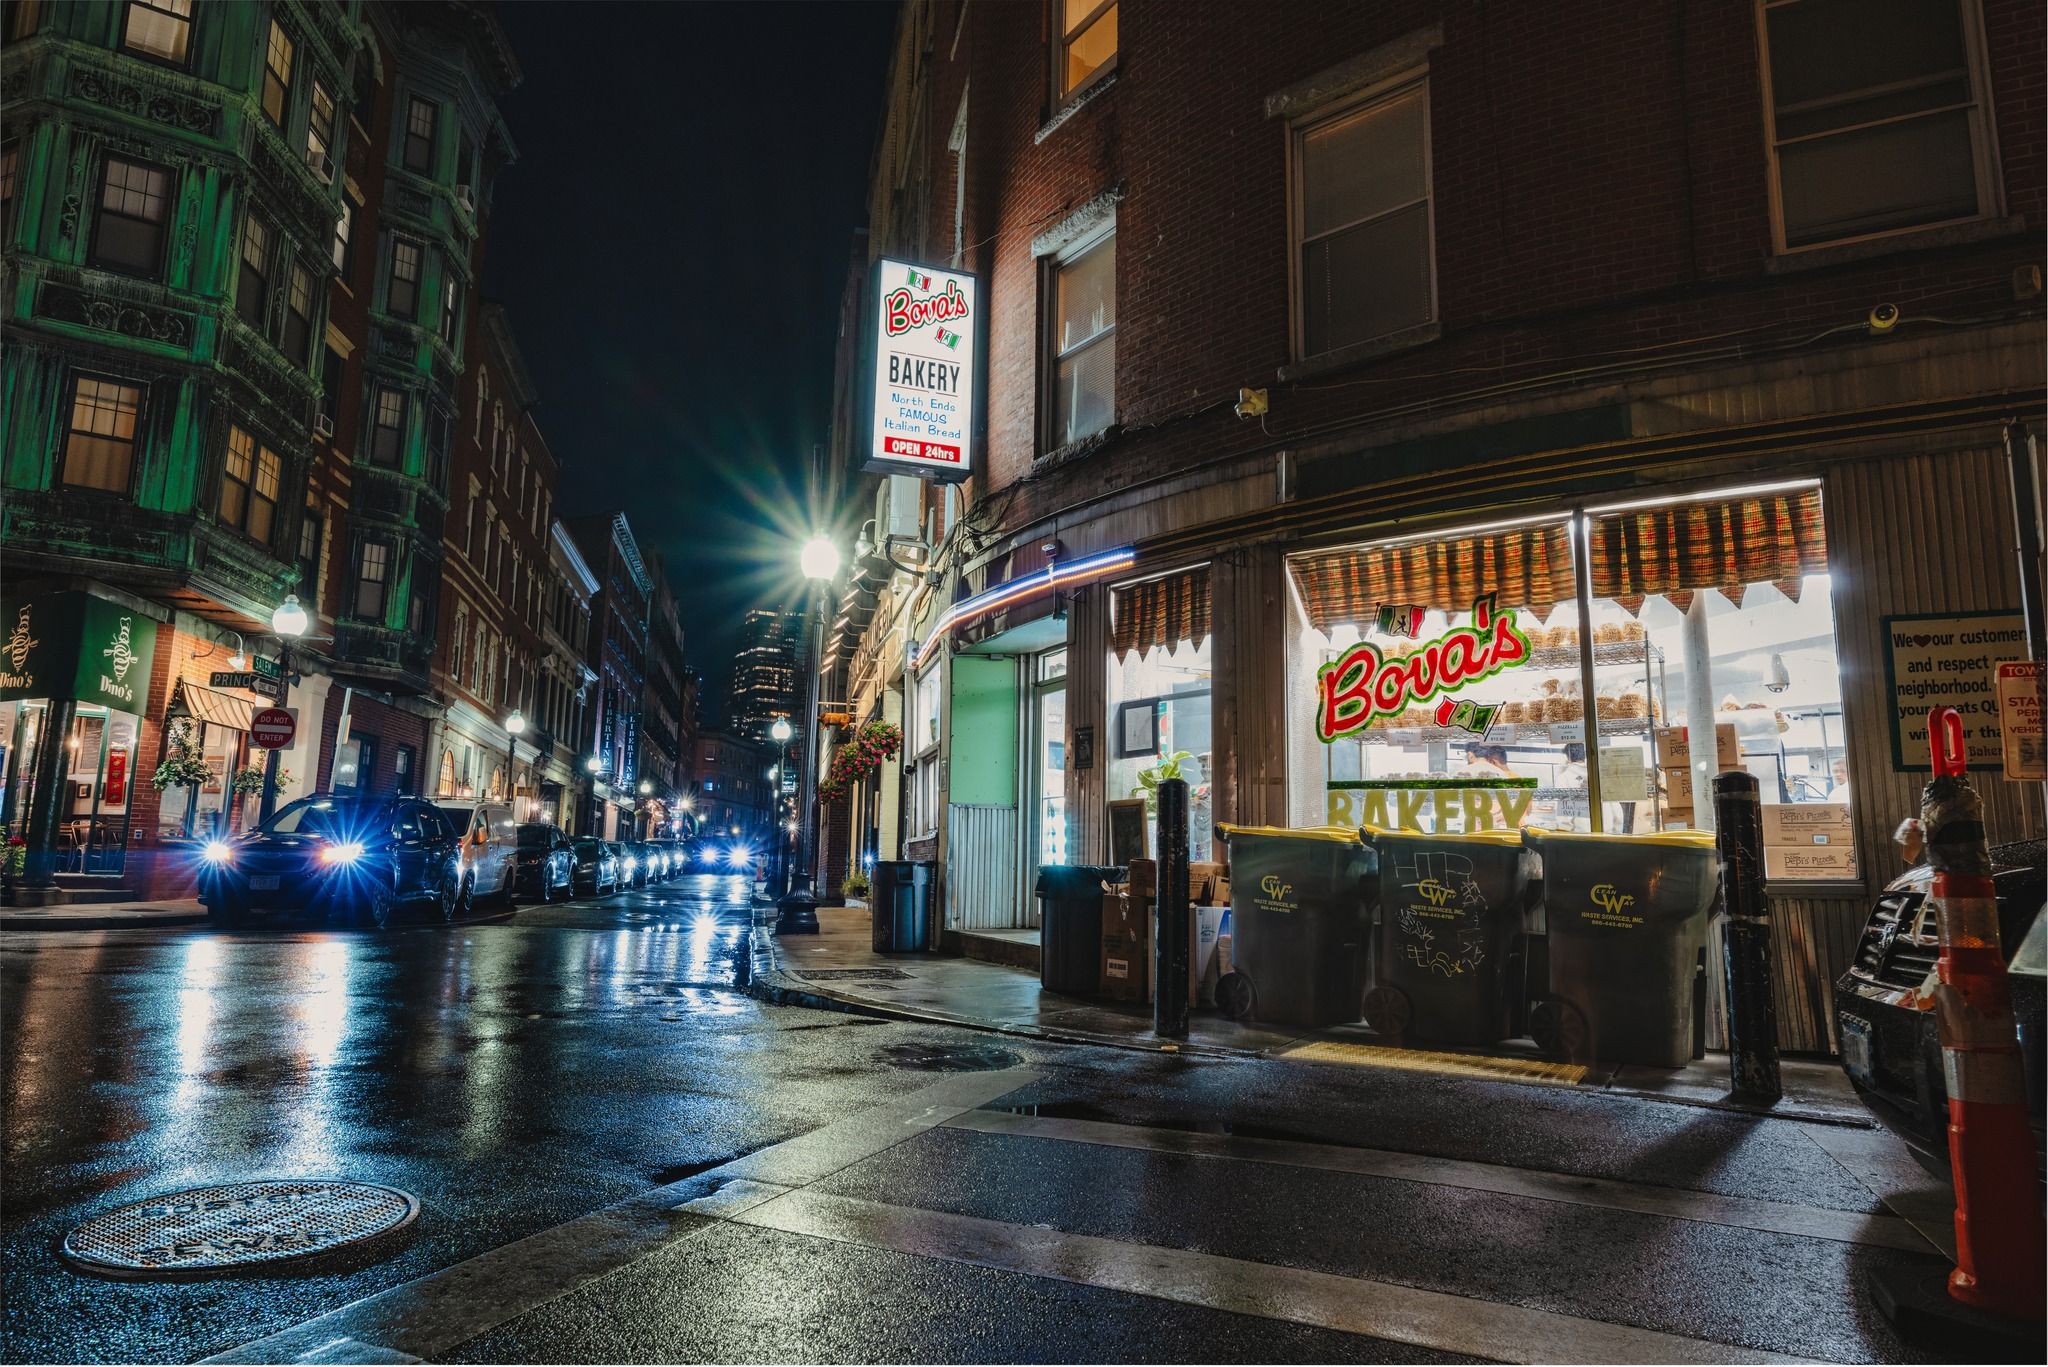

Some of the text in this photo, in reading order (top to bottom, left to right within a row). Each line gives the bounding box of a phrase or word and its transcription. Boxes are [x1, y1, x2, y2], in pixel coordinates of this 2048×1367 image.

[885, 280, 969, 337] Bova's
[889, 355, 960, 393] BAKERY
[891, 393, 956, 412] North Ends
[899, 407, 947, 425] FAMOUS
[884, 417, 960, 439] Italian Bread
[892, 440, 955, 460] OPEN 24hrs
[1893, 633, 1913, 648] We
[1932, 634, 1954, 646] our
[255, 659, 272, 675] SALEM
[1317, 593, 1531, 743] Bova's
[1908, 655, 1990, 674] and respect
[0, 672, 33, 688] Dino's
[100, 675, 133, 702] Dino's
[213, 673, 250, 688] PRINC
[1897, 677, 1992, 699] neighborhood.
[260, 715, 289, 724] DO NOT
[1899, 705, 1931, 719] your
[260, 734, 284, 742] ENTER
[603, 692, 614, 766] LIBERTINE
[626, 716, 636, 780] LIBERTINE
[1327, 789, 1534, 835] BAKERY
